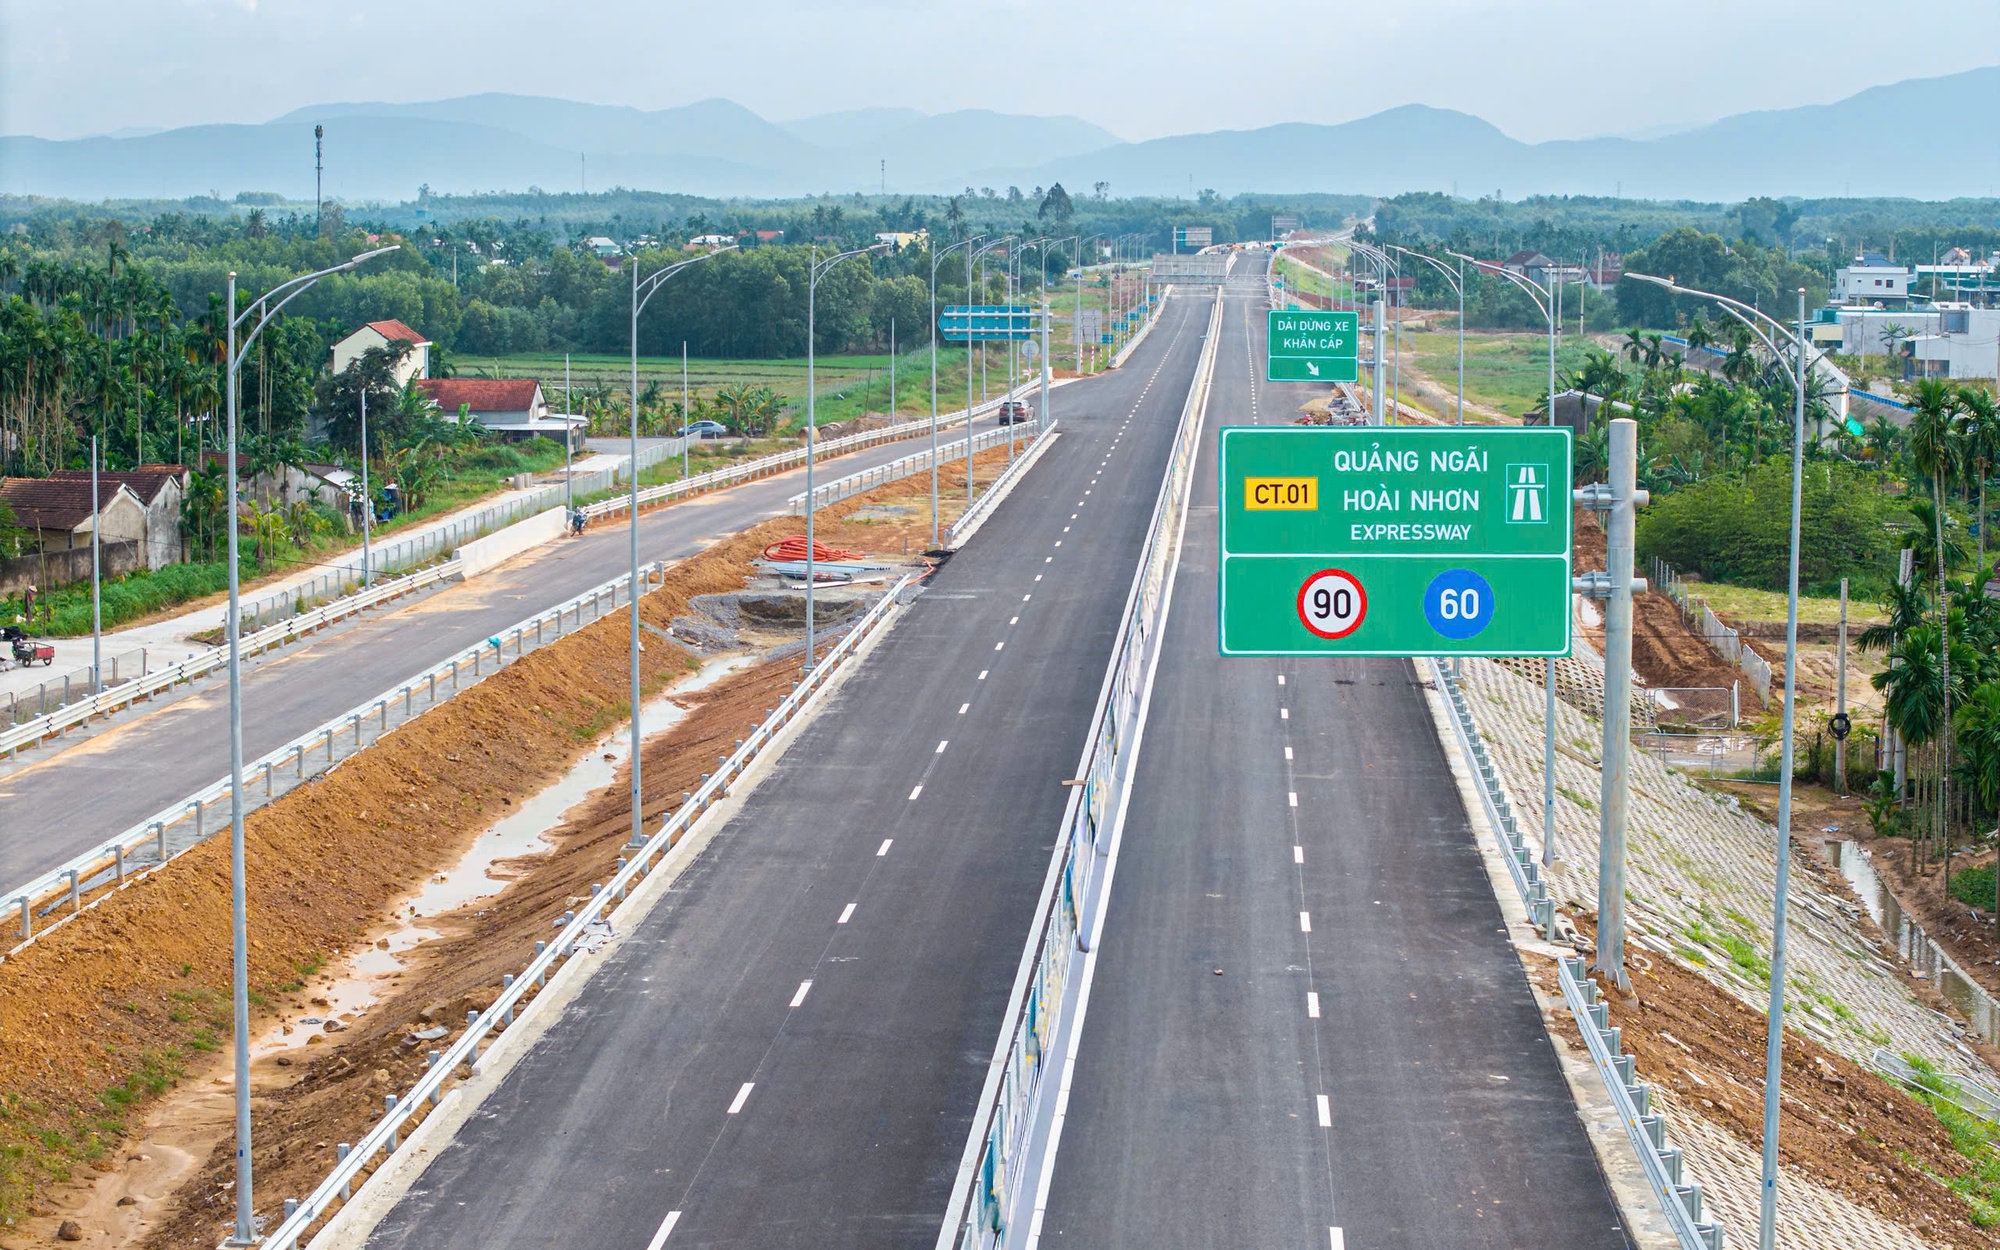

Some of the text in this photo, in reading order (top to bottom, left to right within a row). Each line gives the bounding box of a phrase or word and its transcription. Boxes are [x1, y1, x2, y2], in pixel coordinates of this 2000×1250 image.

[1278, 316, 1349, 332] DẢI DỪNG XE
[1283, 332, 1343, 349] KHẨN CẤP
[1334, 442, 1488, 472] QUẢNG NGÃI
[1254, 484, 1309, 505] CT.01
[1343, 483, 1479, 511] HOÀI NHƠN
[1350, 524, 1472, 541] EXPRESSWAY
[1312, 588, 1352, 620] 90
[1439, 588, 1480, 620] 60
